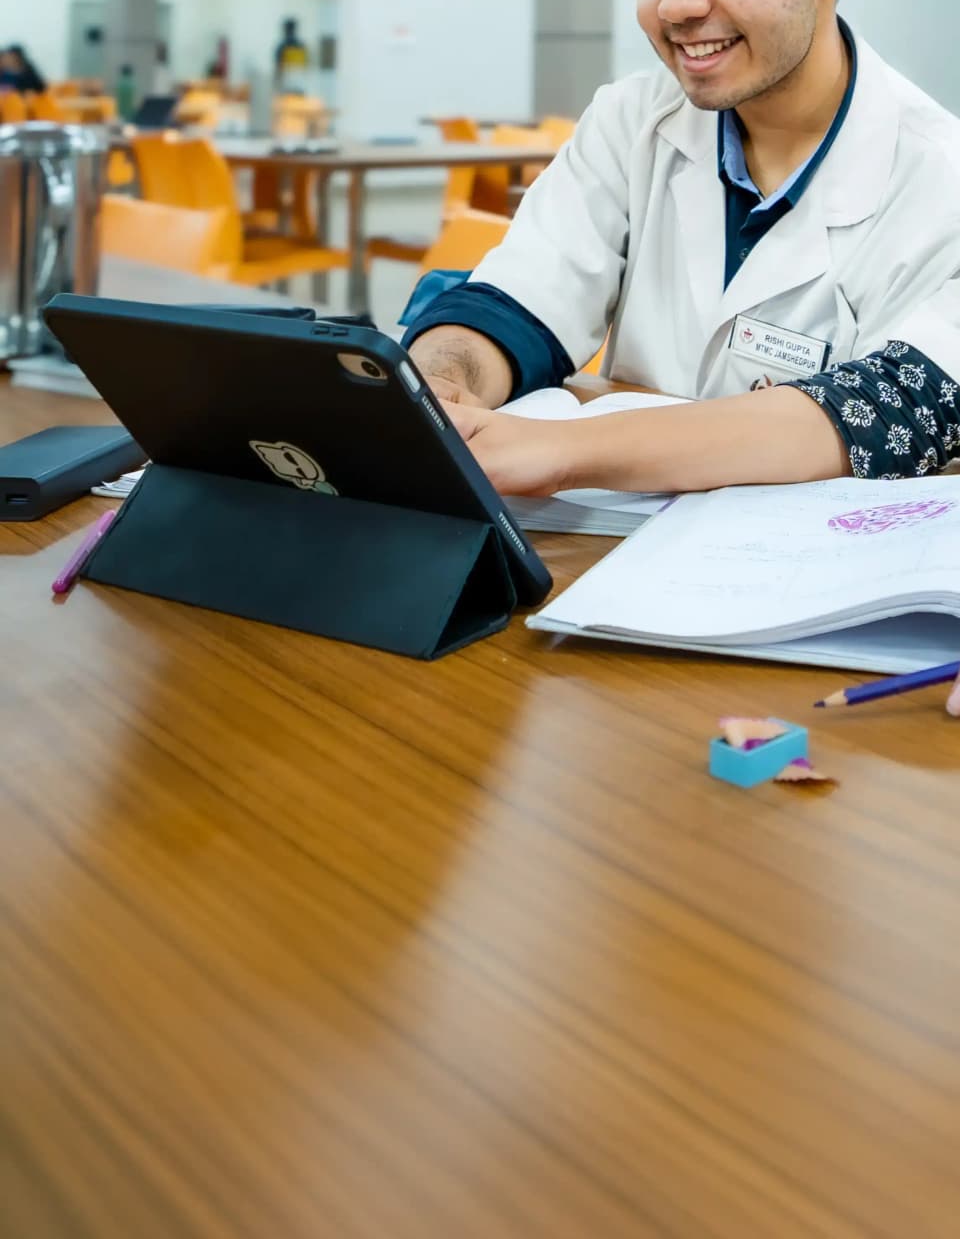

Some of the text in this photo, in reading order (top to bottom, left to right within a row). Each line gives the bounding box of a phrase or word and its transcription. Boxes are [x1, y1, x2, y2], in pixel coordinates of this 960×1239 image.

[765, 334, 810, 355] RISHI GUPTA
[774, 351, 816, 369] JAMSHEDPUR
